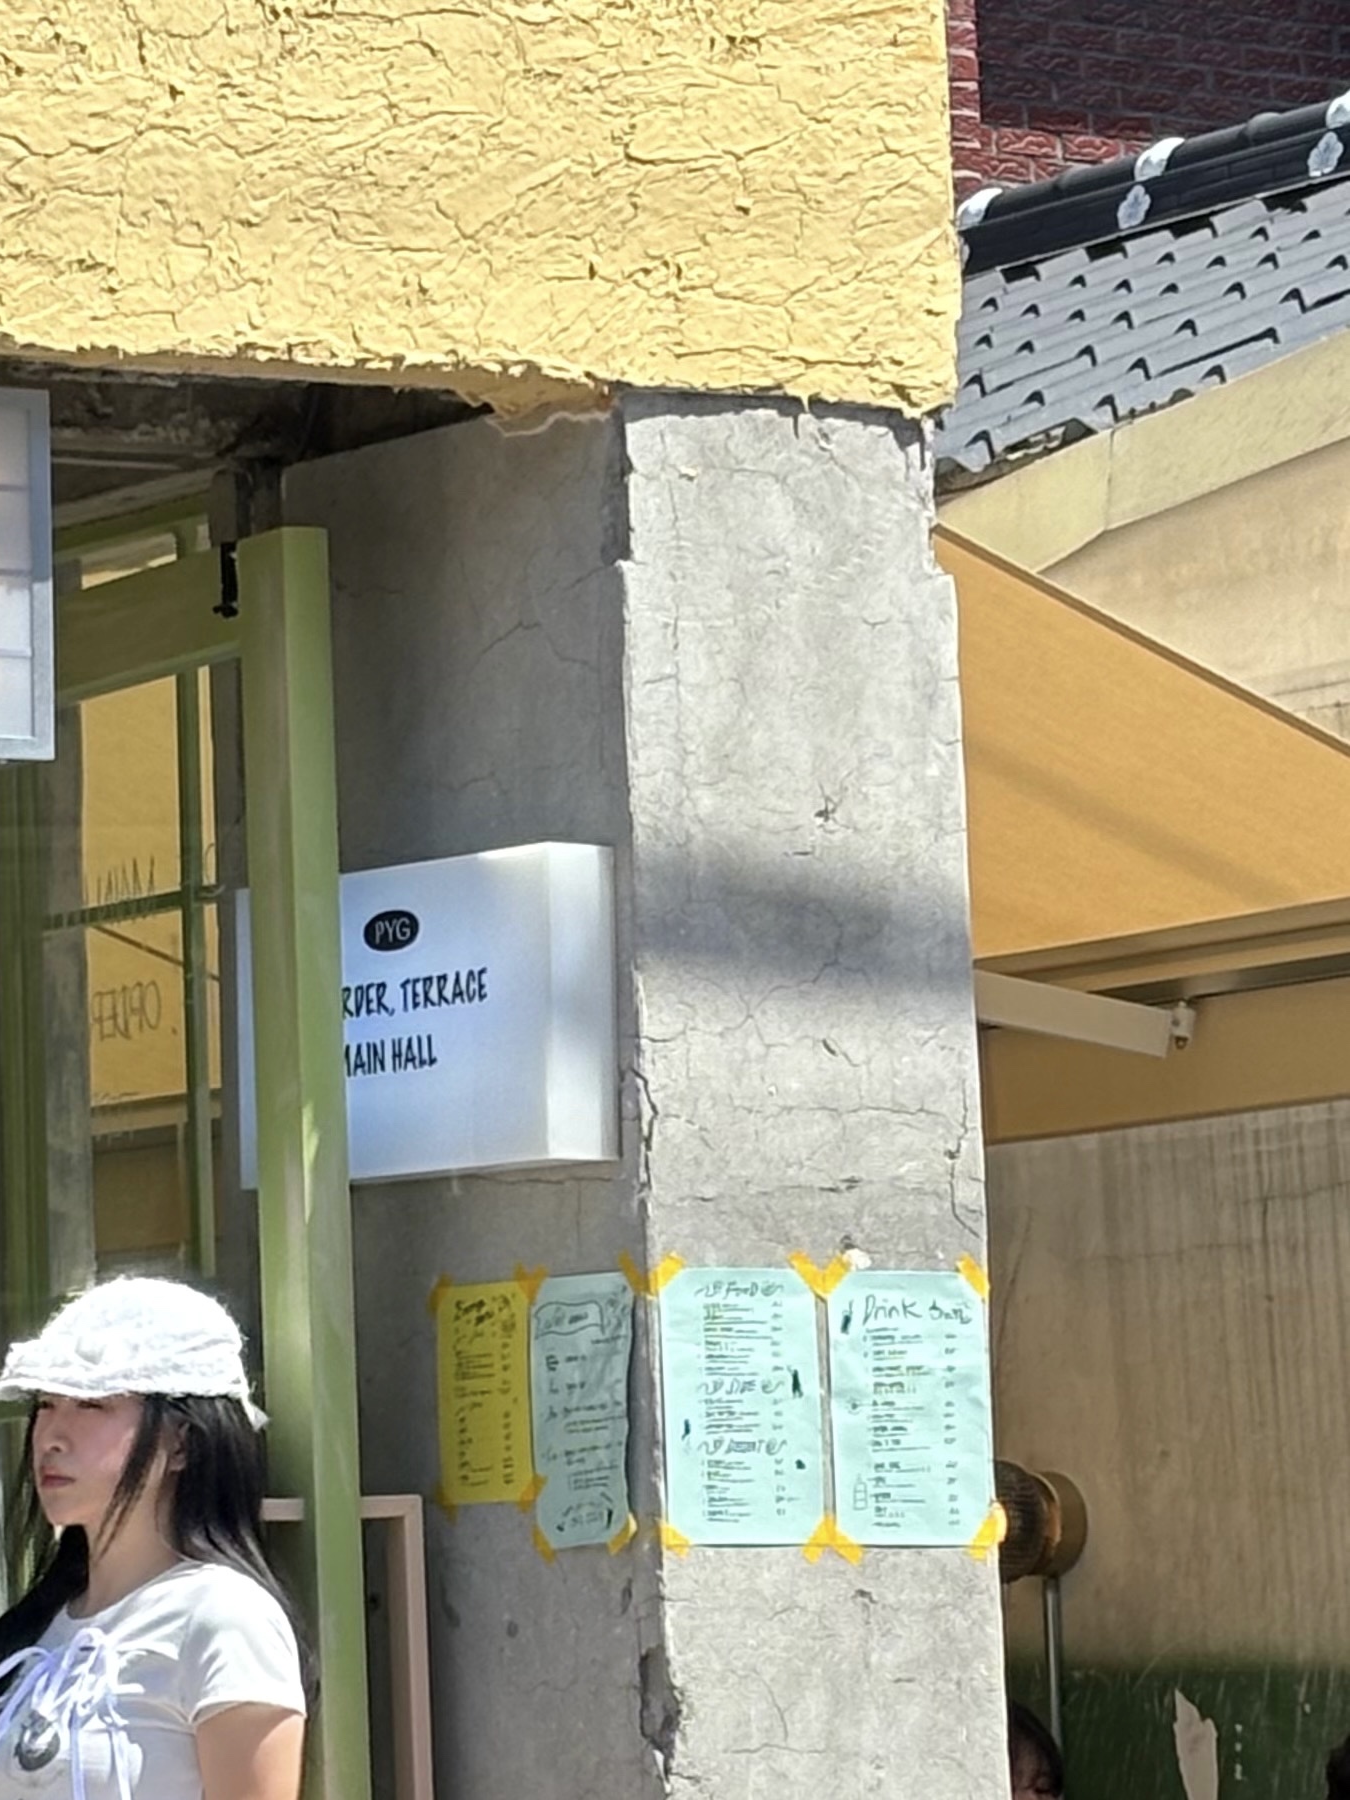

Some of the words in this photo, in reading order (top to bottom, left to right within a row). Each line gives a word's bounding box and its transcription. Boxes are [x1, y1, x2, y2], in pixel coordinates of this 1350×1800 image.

[373, 915, 412, 946] PYG
[400, 966, 489, 1014] TERRACE
[391, 1033, 438, 1074] HALL
